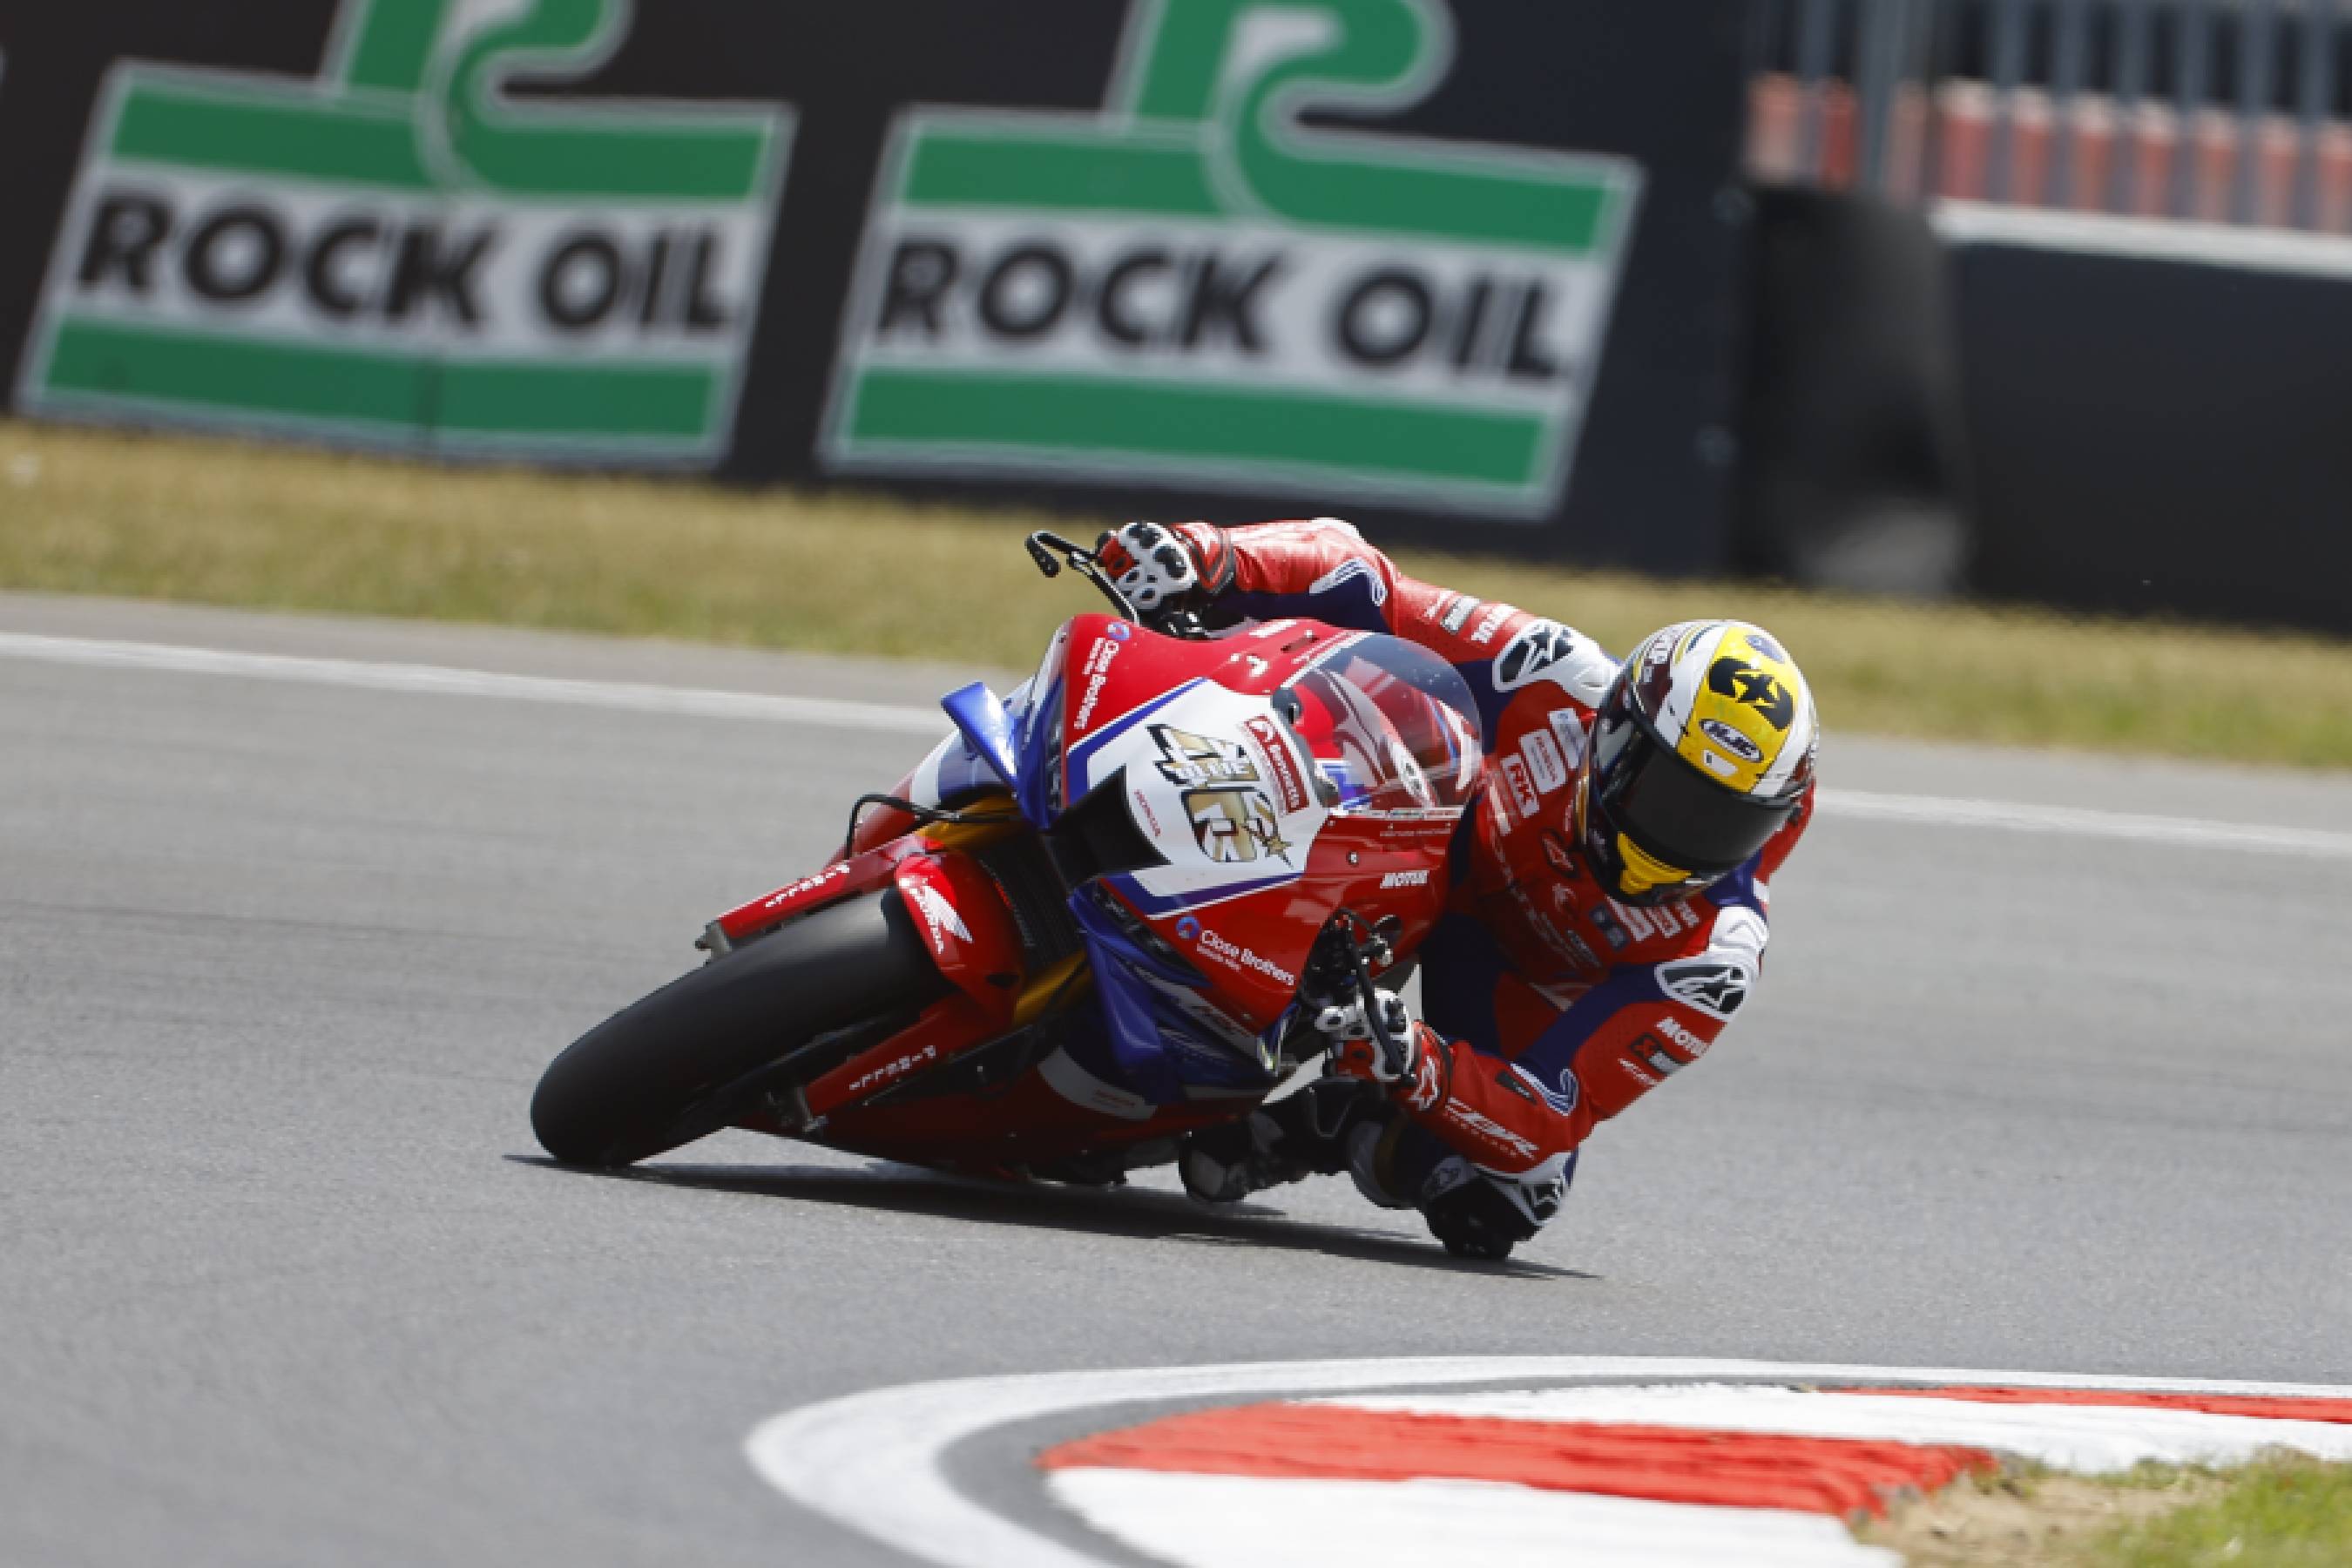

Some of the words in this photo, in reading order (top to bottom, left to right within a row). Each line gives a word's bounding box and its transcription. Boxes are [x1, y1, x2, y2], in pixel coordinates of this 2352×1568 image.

[75, 193, 498, 333] ROCK
[536, 223, 738, 336] OIL
[878, 238, 1288, 355] ROCK
[1335, 261, 1565, 382] OIL
[1704, 720, 1757, 760] HJC
[1200, 929, 1240, 959] Close
[1240, 948, 1295, 986] Brothers
